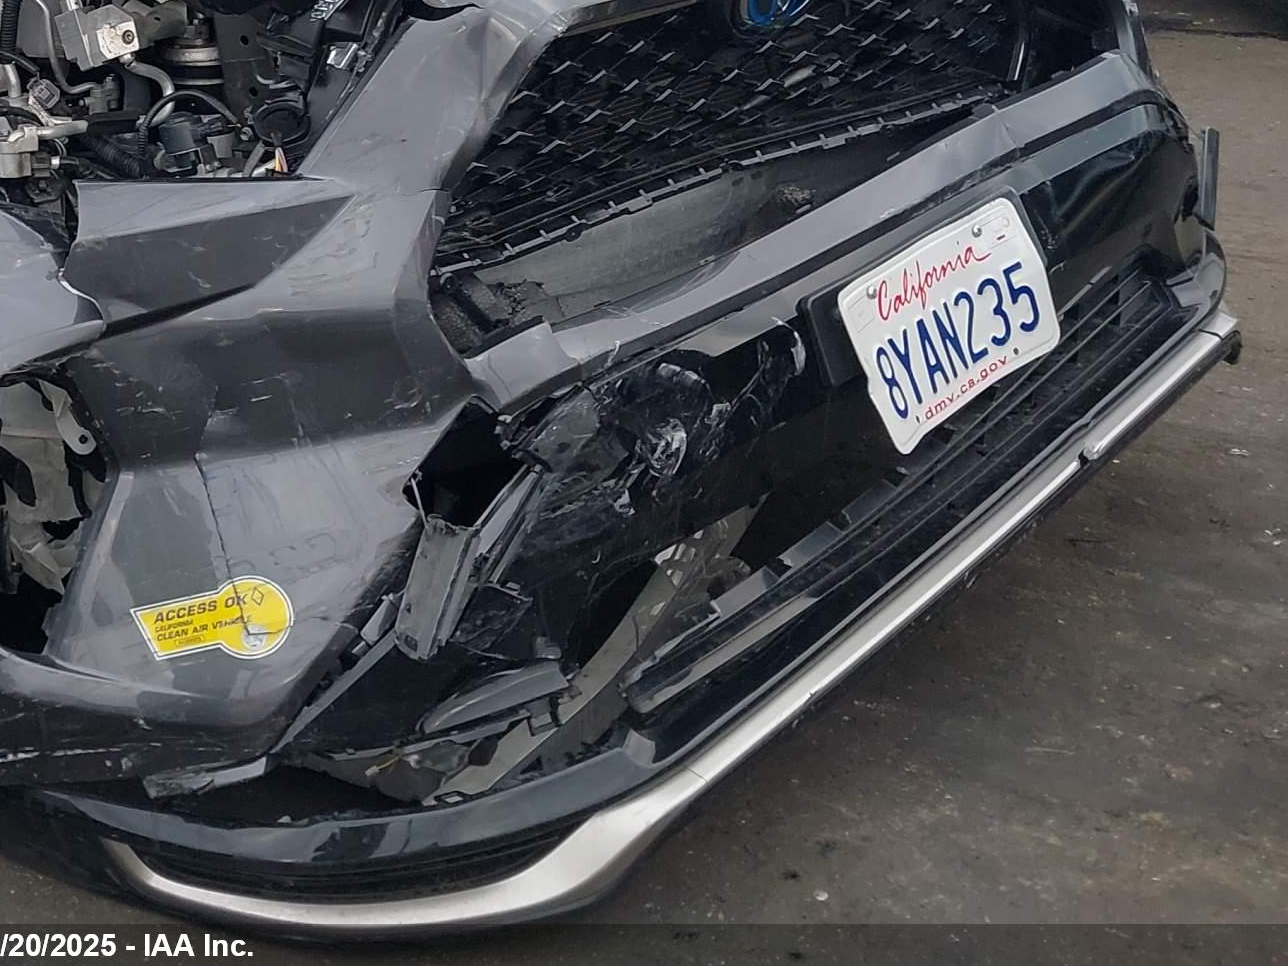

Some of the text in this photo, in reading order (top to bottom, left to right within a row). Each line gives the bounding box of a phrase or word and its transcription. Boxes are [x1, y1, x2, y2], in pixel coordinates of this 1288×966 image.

[876, 239, 992, 321] California
[876, 261, 1040, 419] 8YAN235
[924, 356, 1009, 421] dmv.ca.gov
[153, 593, 248, 624] ACCESS OK
[157, 628, 189, 642] CLEAN
[192, 623, 209, 635] AIR
